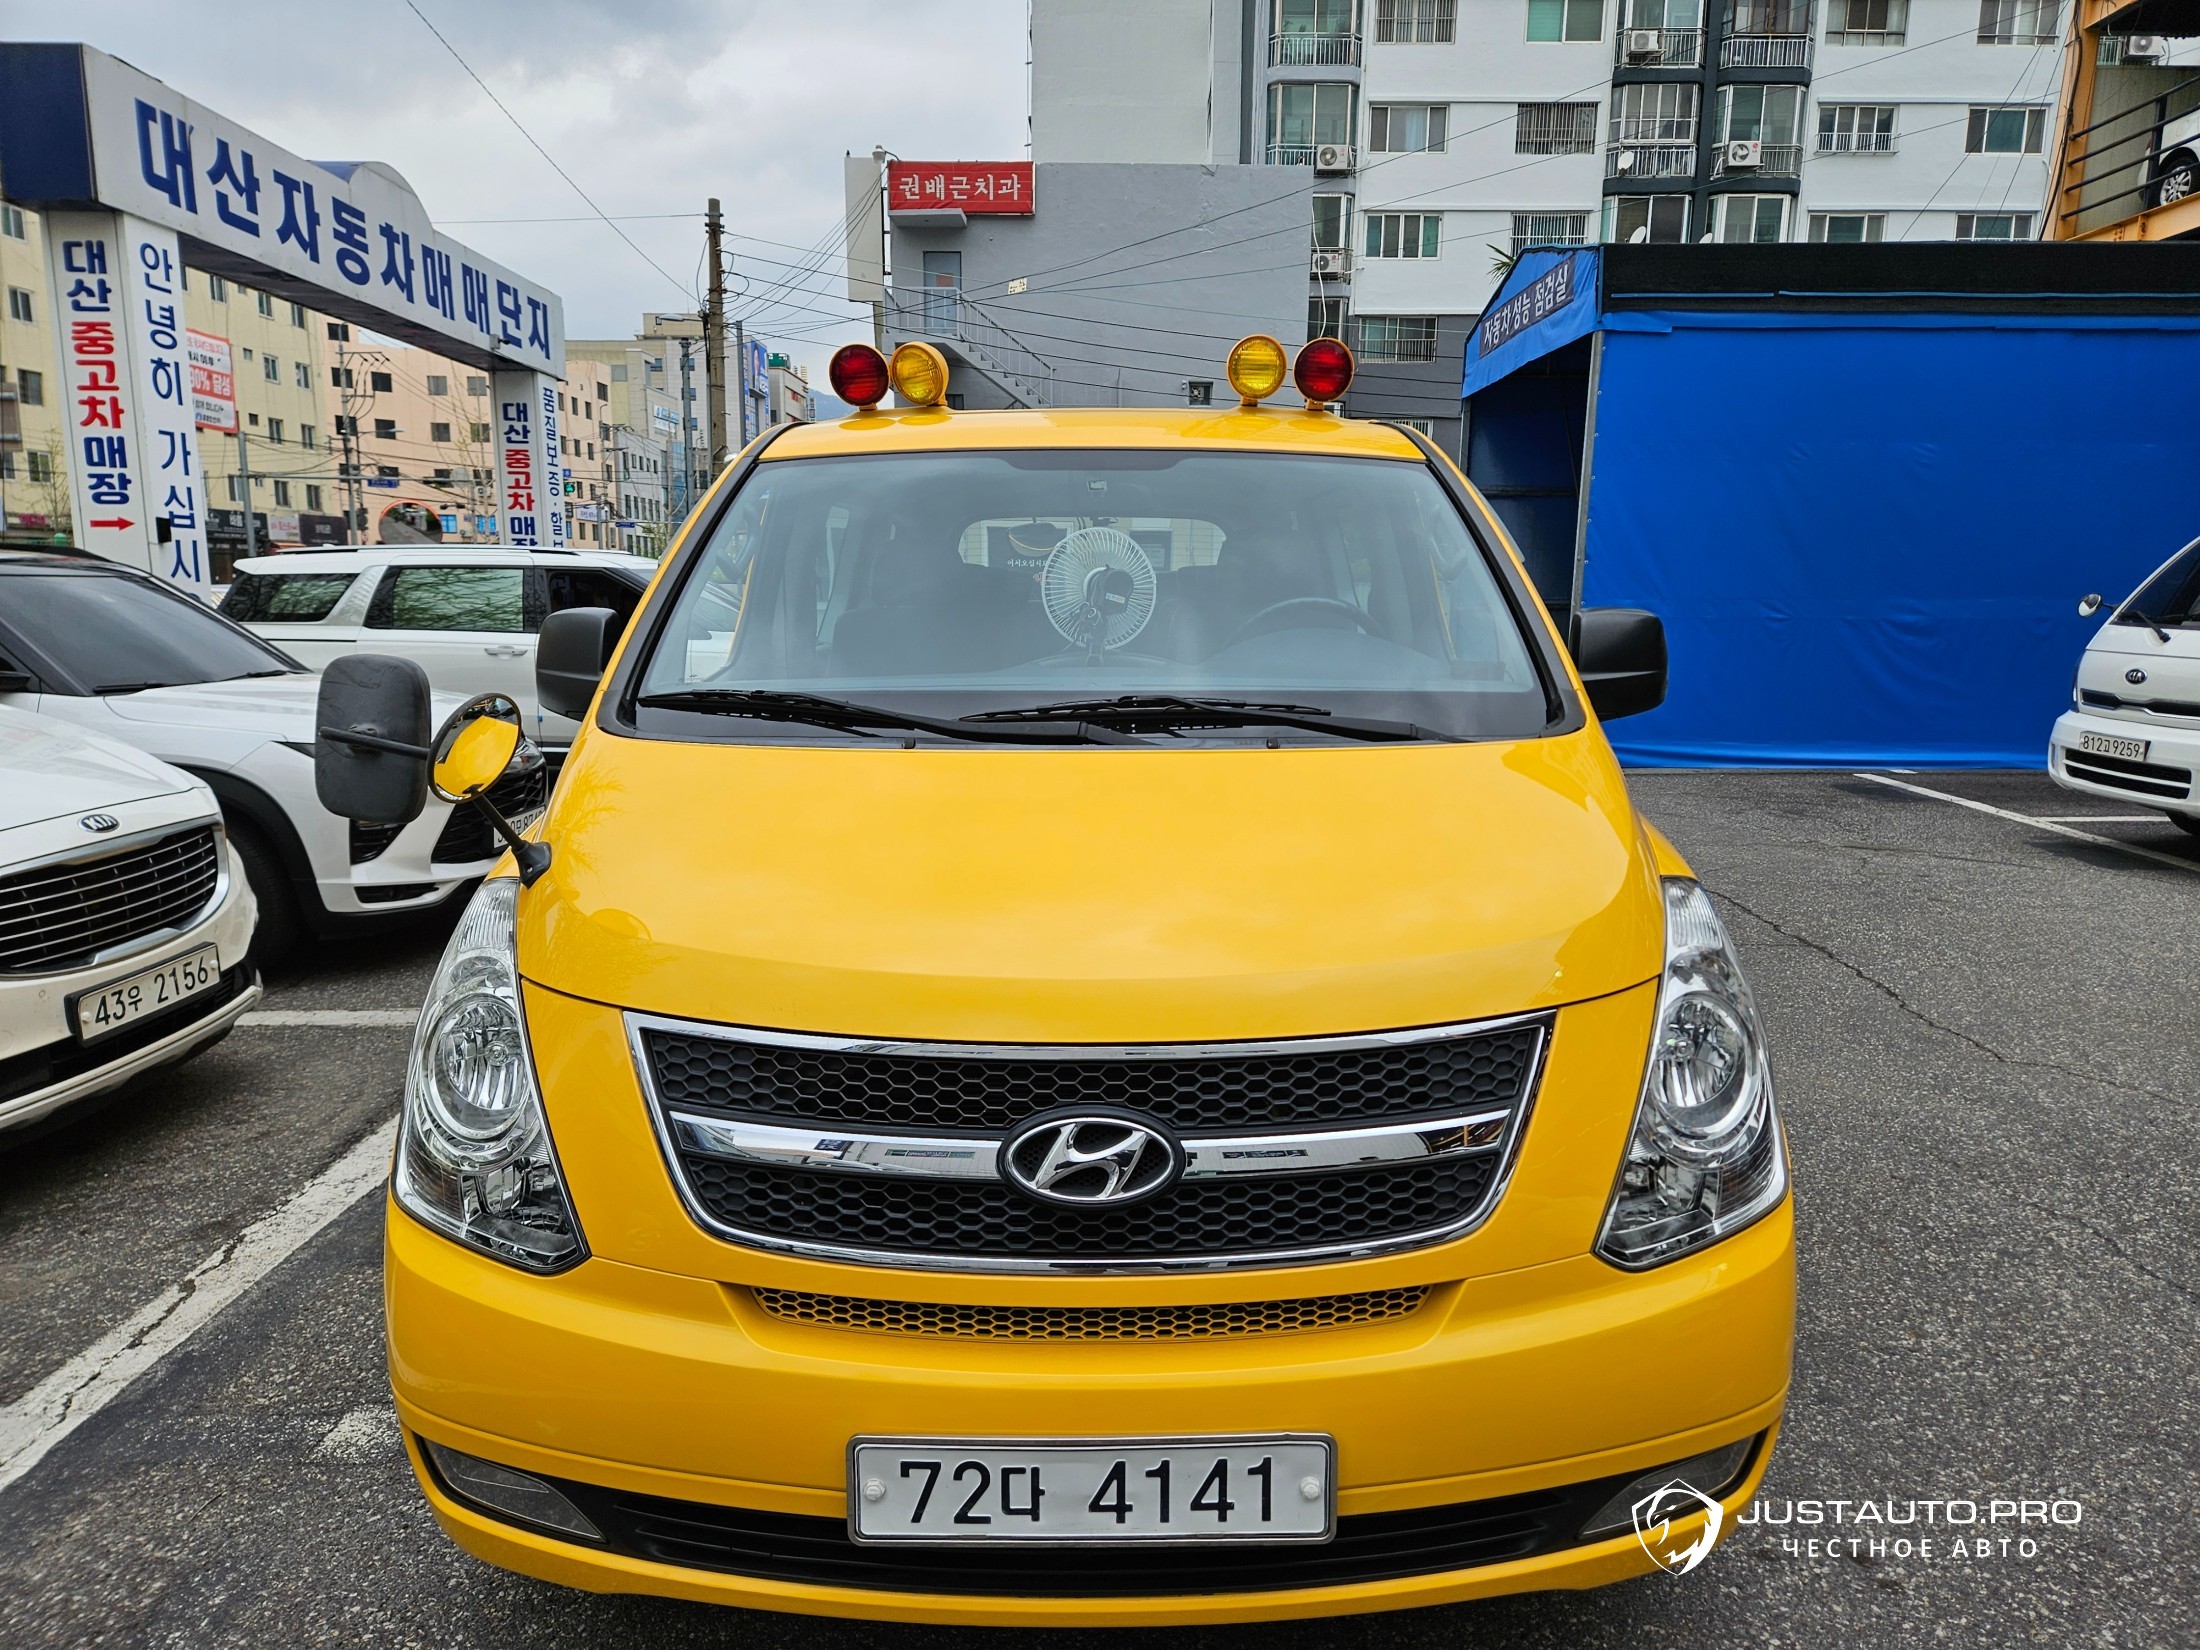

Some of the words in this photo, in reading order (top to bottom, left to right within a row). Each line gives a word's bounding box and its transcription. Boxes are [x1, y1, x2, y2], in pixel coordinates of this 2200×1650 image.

[140, 242, 184, 406] 안녕히
[158, 429, 201, 601] 가십시
[2128, 671, 2142, 682] KIA
[83, 815, 117, 830] KIA
[95, 985, 143, 1026] 43우
[153, 955, 209, 1004] 2156
[900, 1460, 1046, 1524] 72다
[1088, 1457, 1272, 1524] 4141
